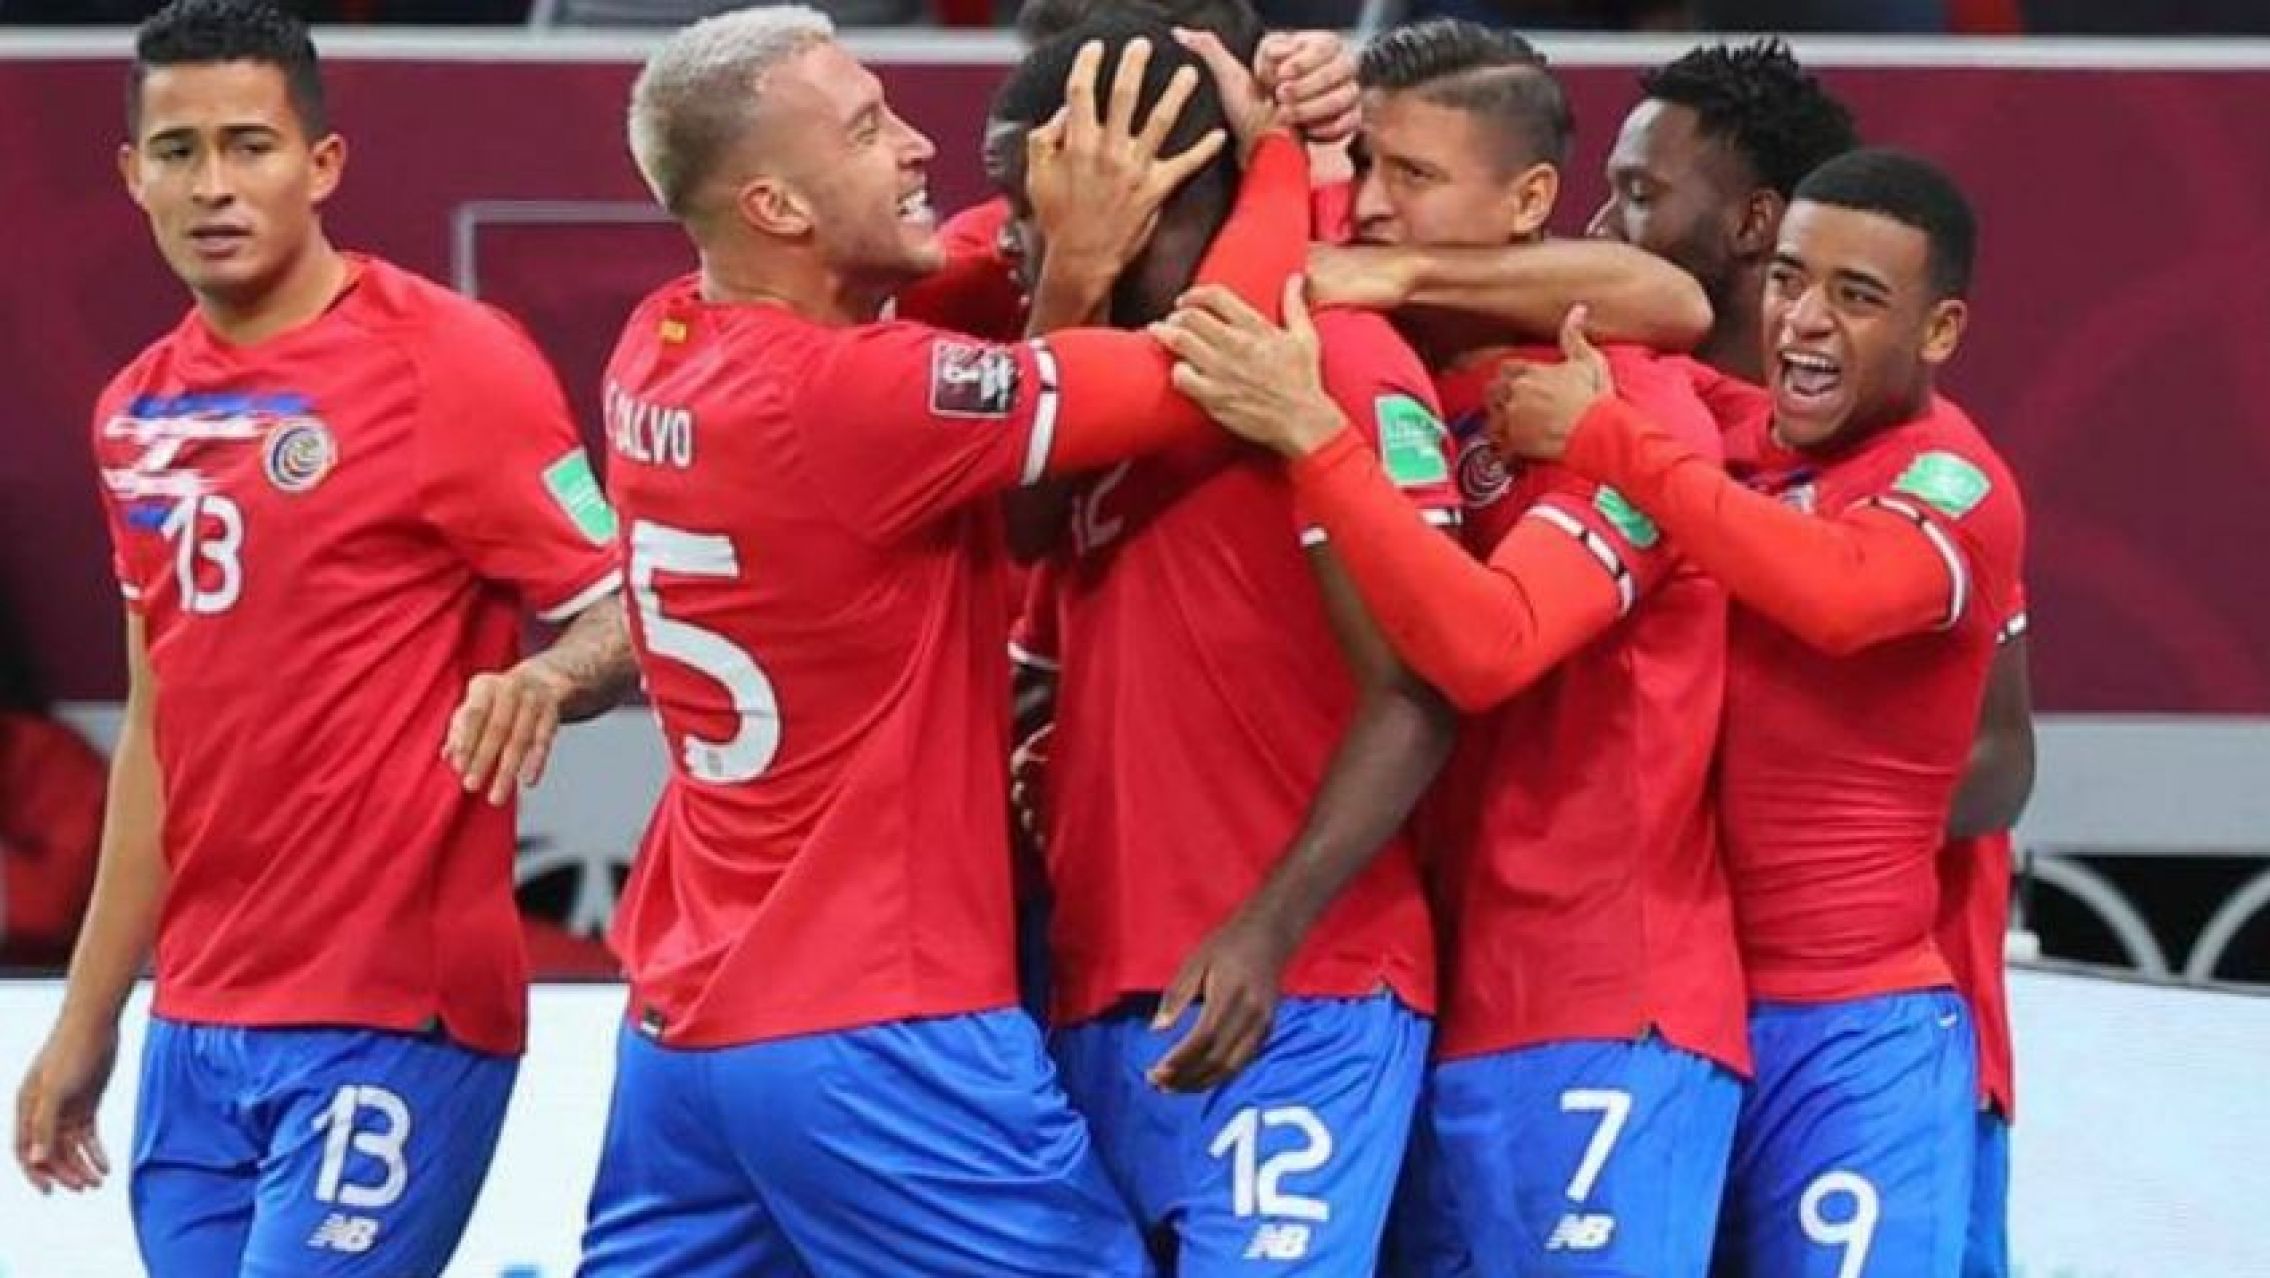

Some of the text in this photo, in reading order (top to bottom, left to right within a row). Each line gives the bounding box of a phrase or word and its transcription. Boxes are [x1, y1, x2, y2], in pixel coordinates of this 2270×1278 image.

[160, 495, 243, 613] 13
[310, 1084, 411, 1207] 13
[1208, 1106, 1333, 1222] 12
[1560, 1088, 1632, 1203] 7
[1799, 1170, 1879, 1278] 9
